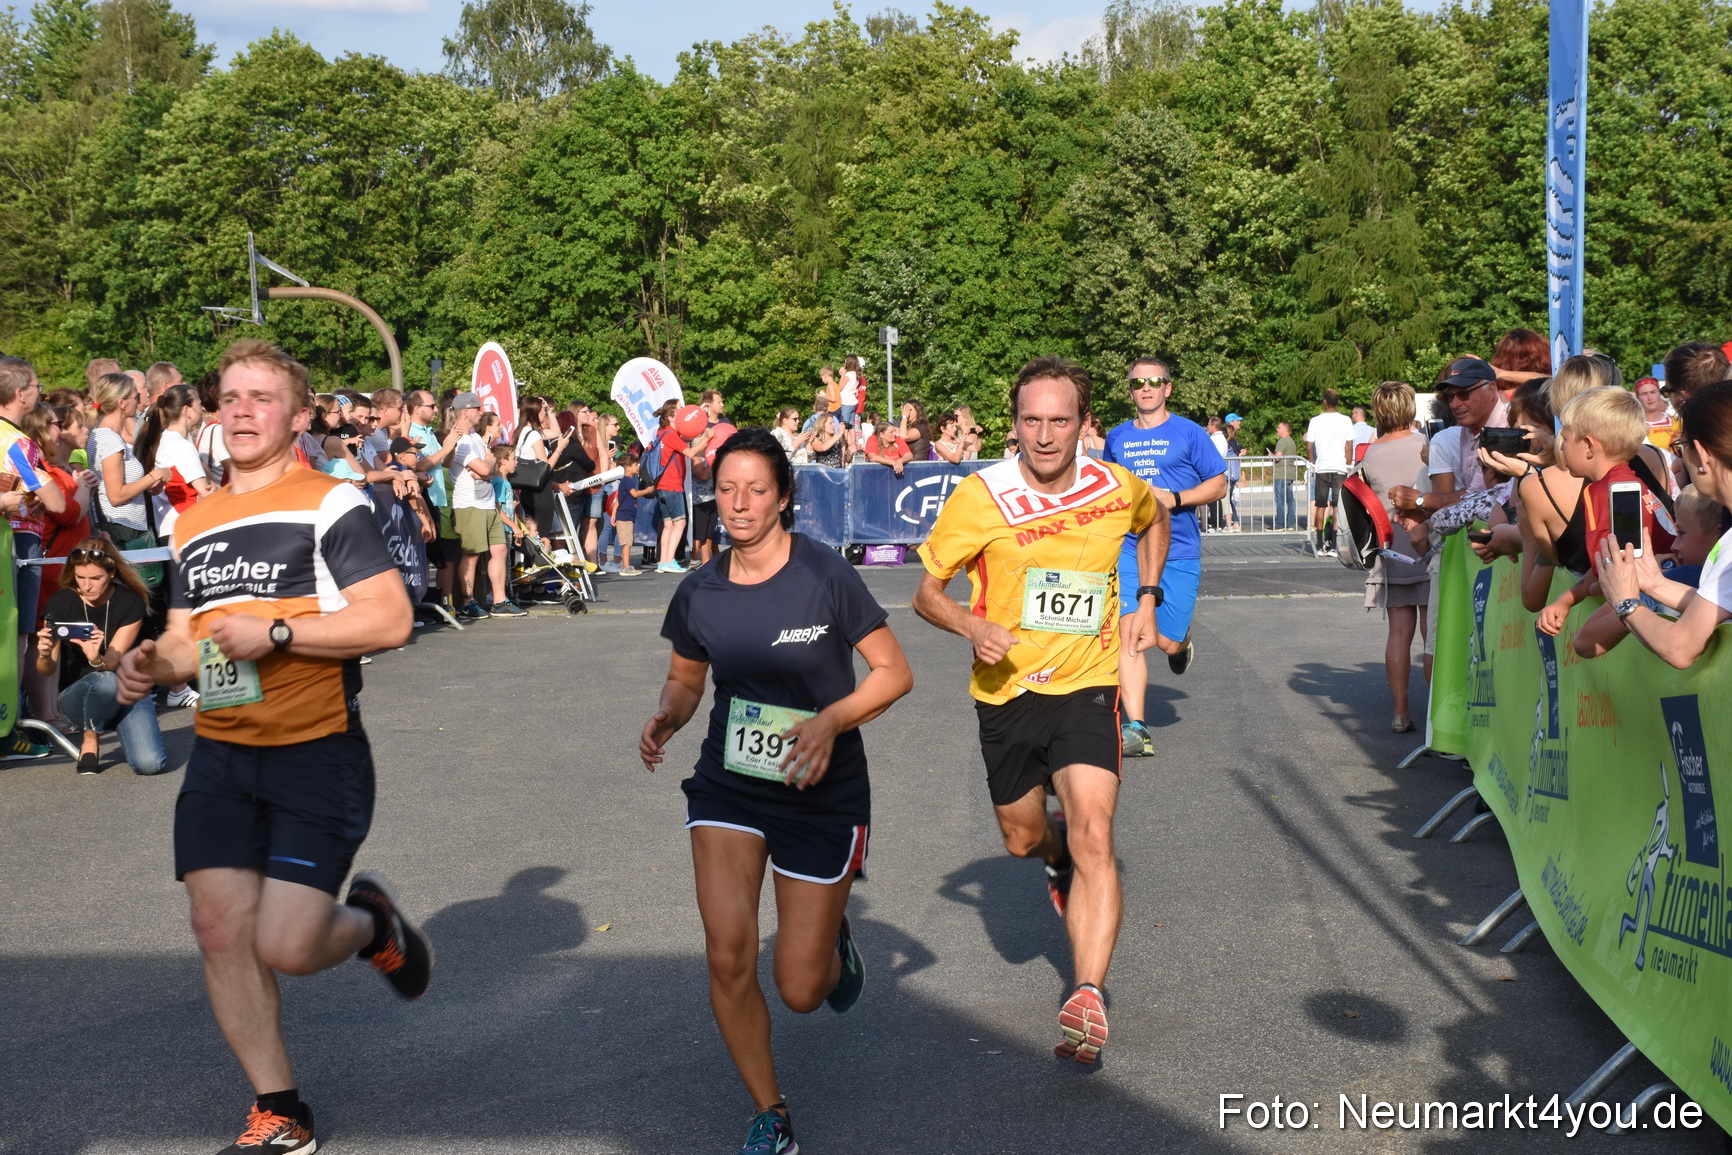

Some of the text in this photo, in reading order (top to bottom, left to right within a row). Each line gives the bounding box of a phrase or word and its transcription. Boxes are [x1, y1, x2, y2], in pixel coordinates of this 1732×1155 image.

[1124, 441, 1142, 449] Wenn
[1124, 448, 1168, 458] Hausverkauf
[1134, 459, 1155, 467] richtig
[1015, 497, 1131, 547] MAX BÖGL
[188, 556, 287, 590] Fischer
[1036, 591, 1094, 617] 1671
[1040, 614, 1065, 622] Schmid
[771, 627, 812, 646] JURA
[205, 660, 239, 689] 739
[1679, 748, 1704, 776] Fischer
[1650, 947, 1698, 985] neumarkt
